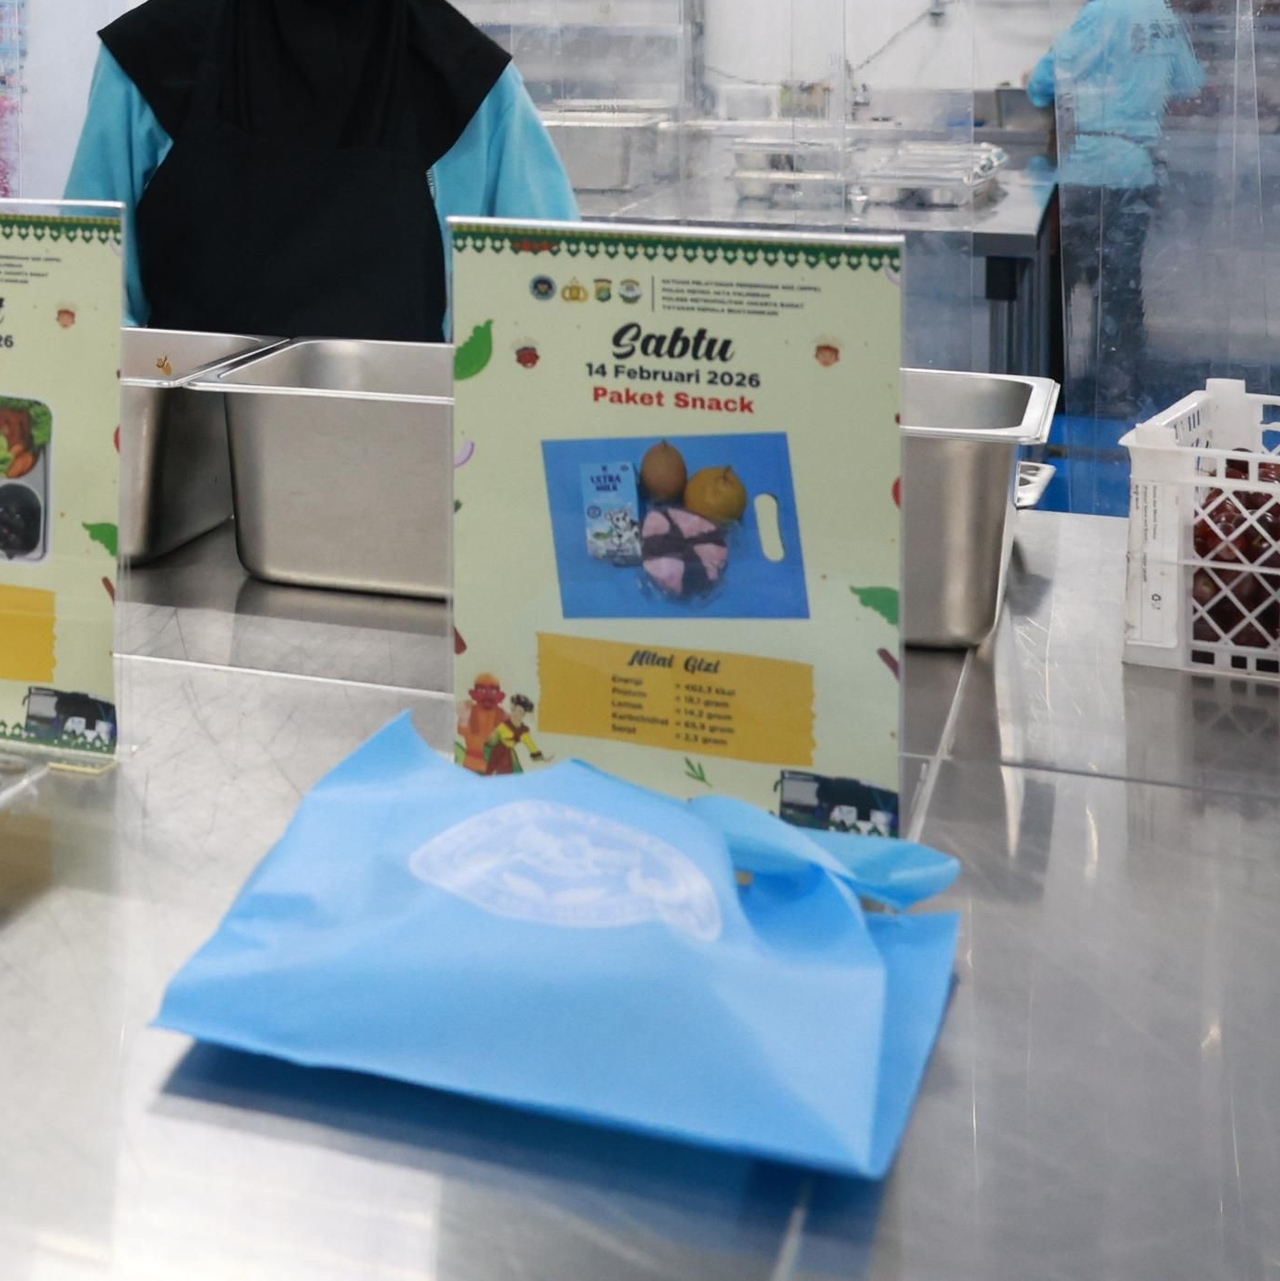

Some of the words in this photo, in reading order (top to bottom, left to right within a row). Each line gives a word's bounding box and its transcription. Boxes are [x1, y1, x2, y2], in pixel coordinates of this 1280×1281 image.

[611, 322, 735, 364] Sabtu
[586, 363, 606, 378] 14
[614, 364, 700, 384] Februari
[707, 371, 761, 388] 2026
[593, 387, 665, 408] Paket
[674, 392, 754, 414] Snack
[628, 650, 674, 668] Nilai
[684, 654, 720, 674] Gizi
